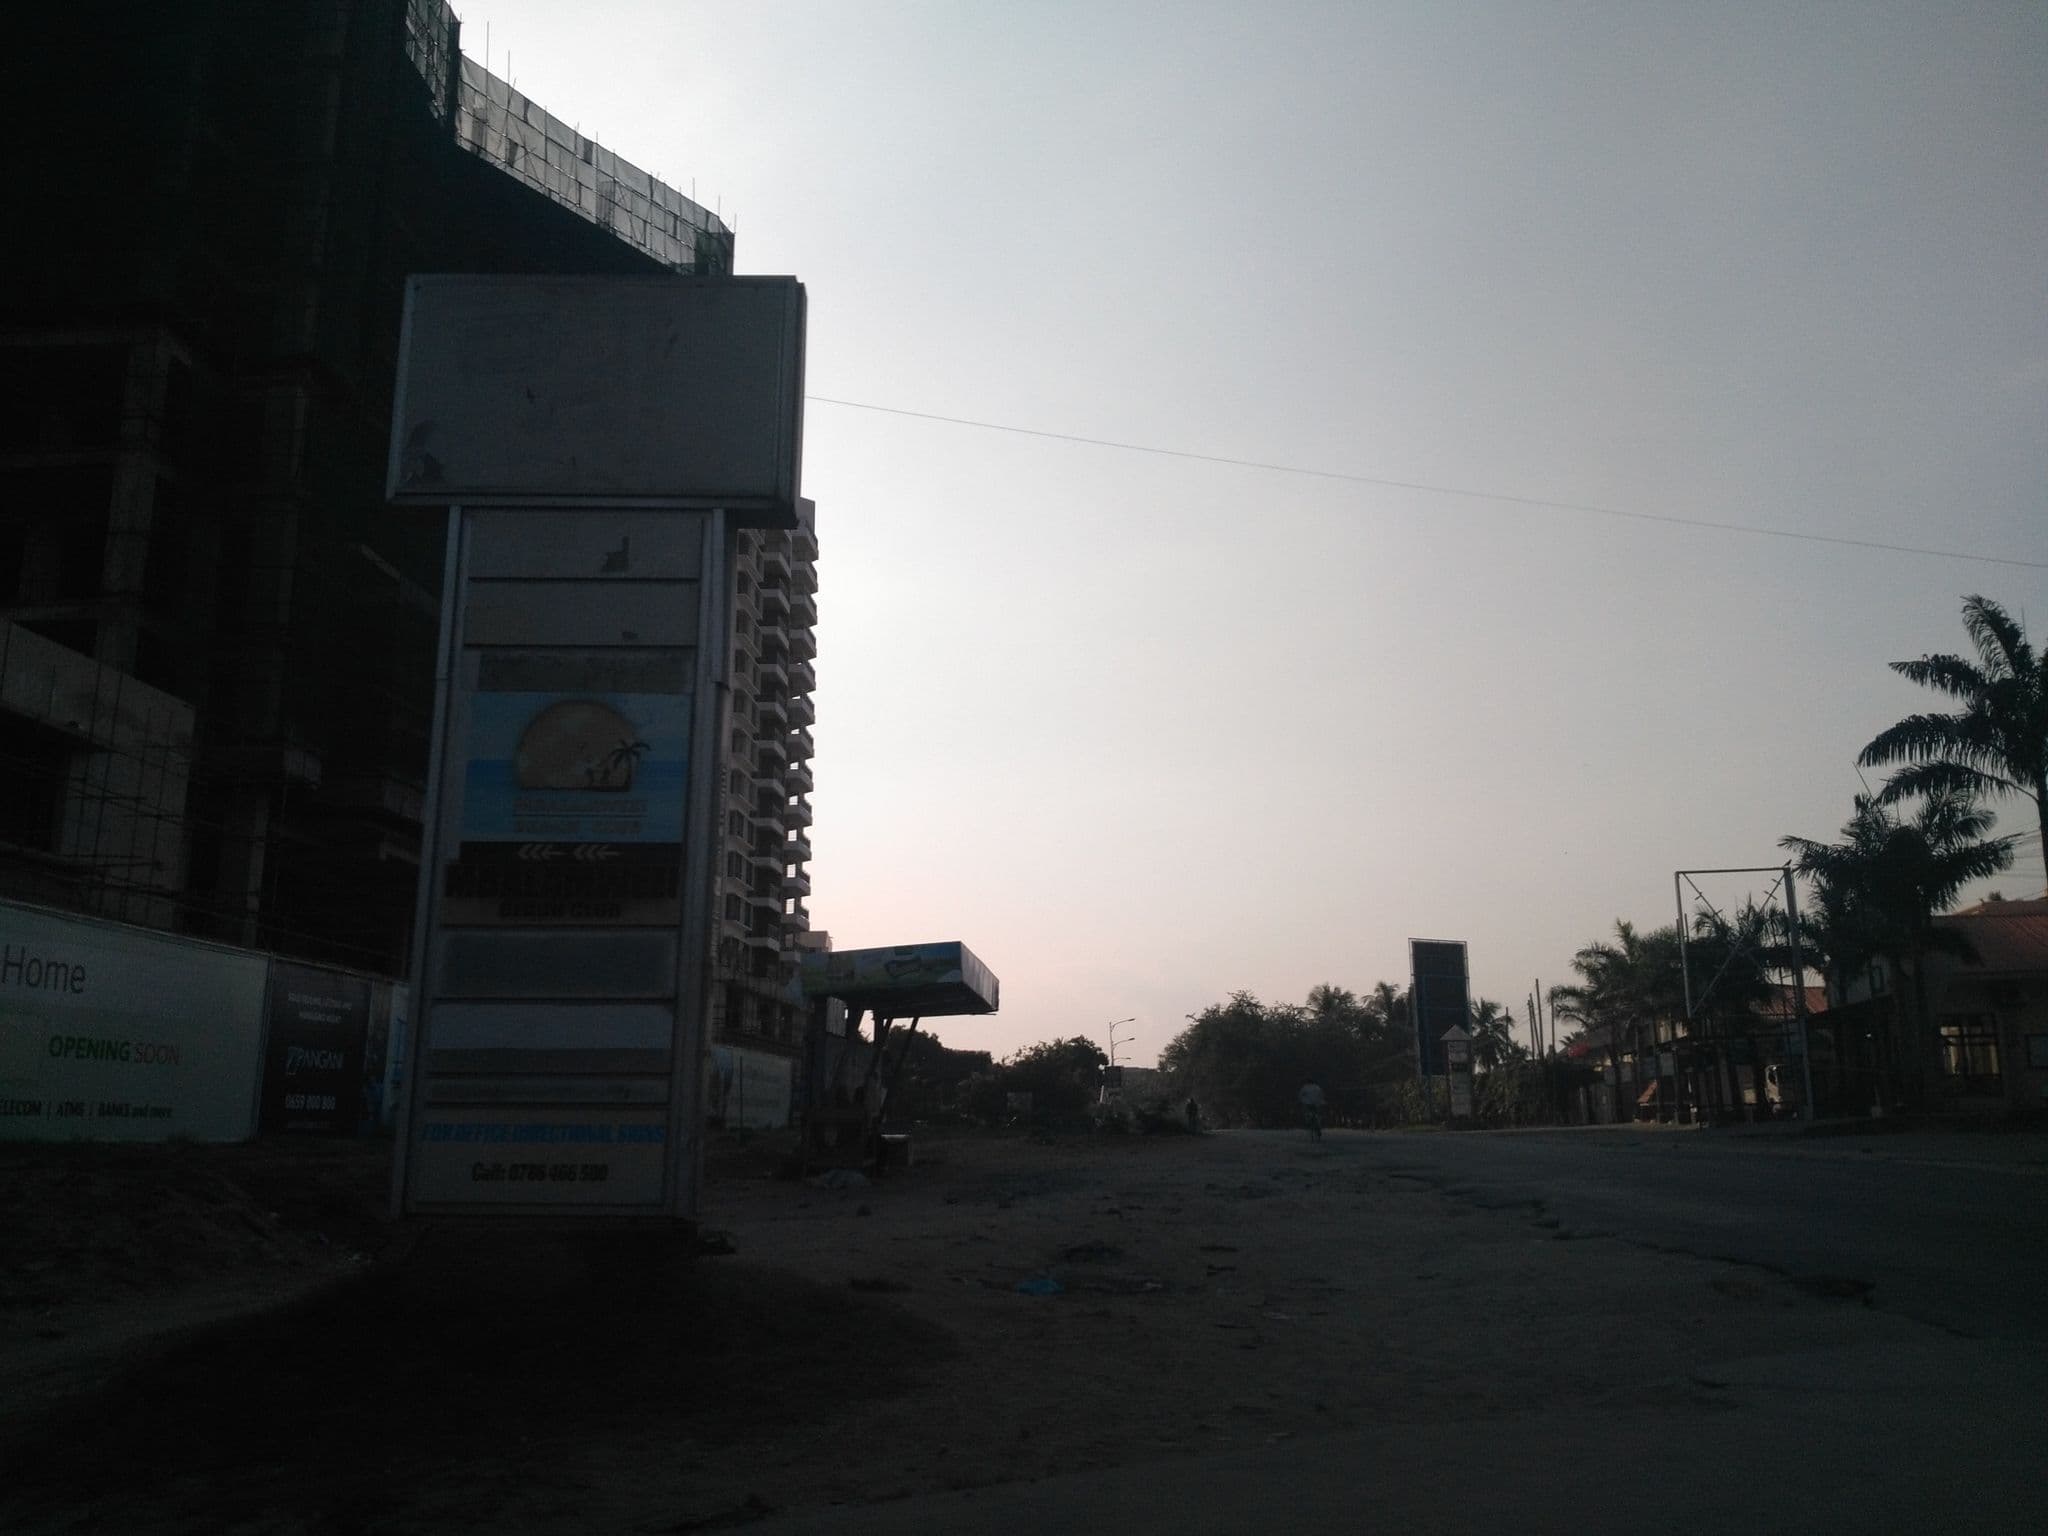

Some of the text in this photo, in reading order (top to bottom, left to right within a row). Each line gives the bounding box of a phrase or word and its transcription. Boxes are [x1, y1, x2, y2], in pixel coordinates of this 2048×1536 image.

[1, 944, 86, 994] Home
[49, 1035, 181, 1065] OPENING SOON
